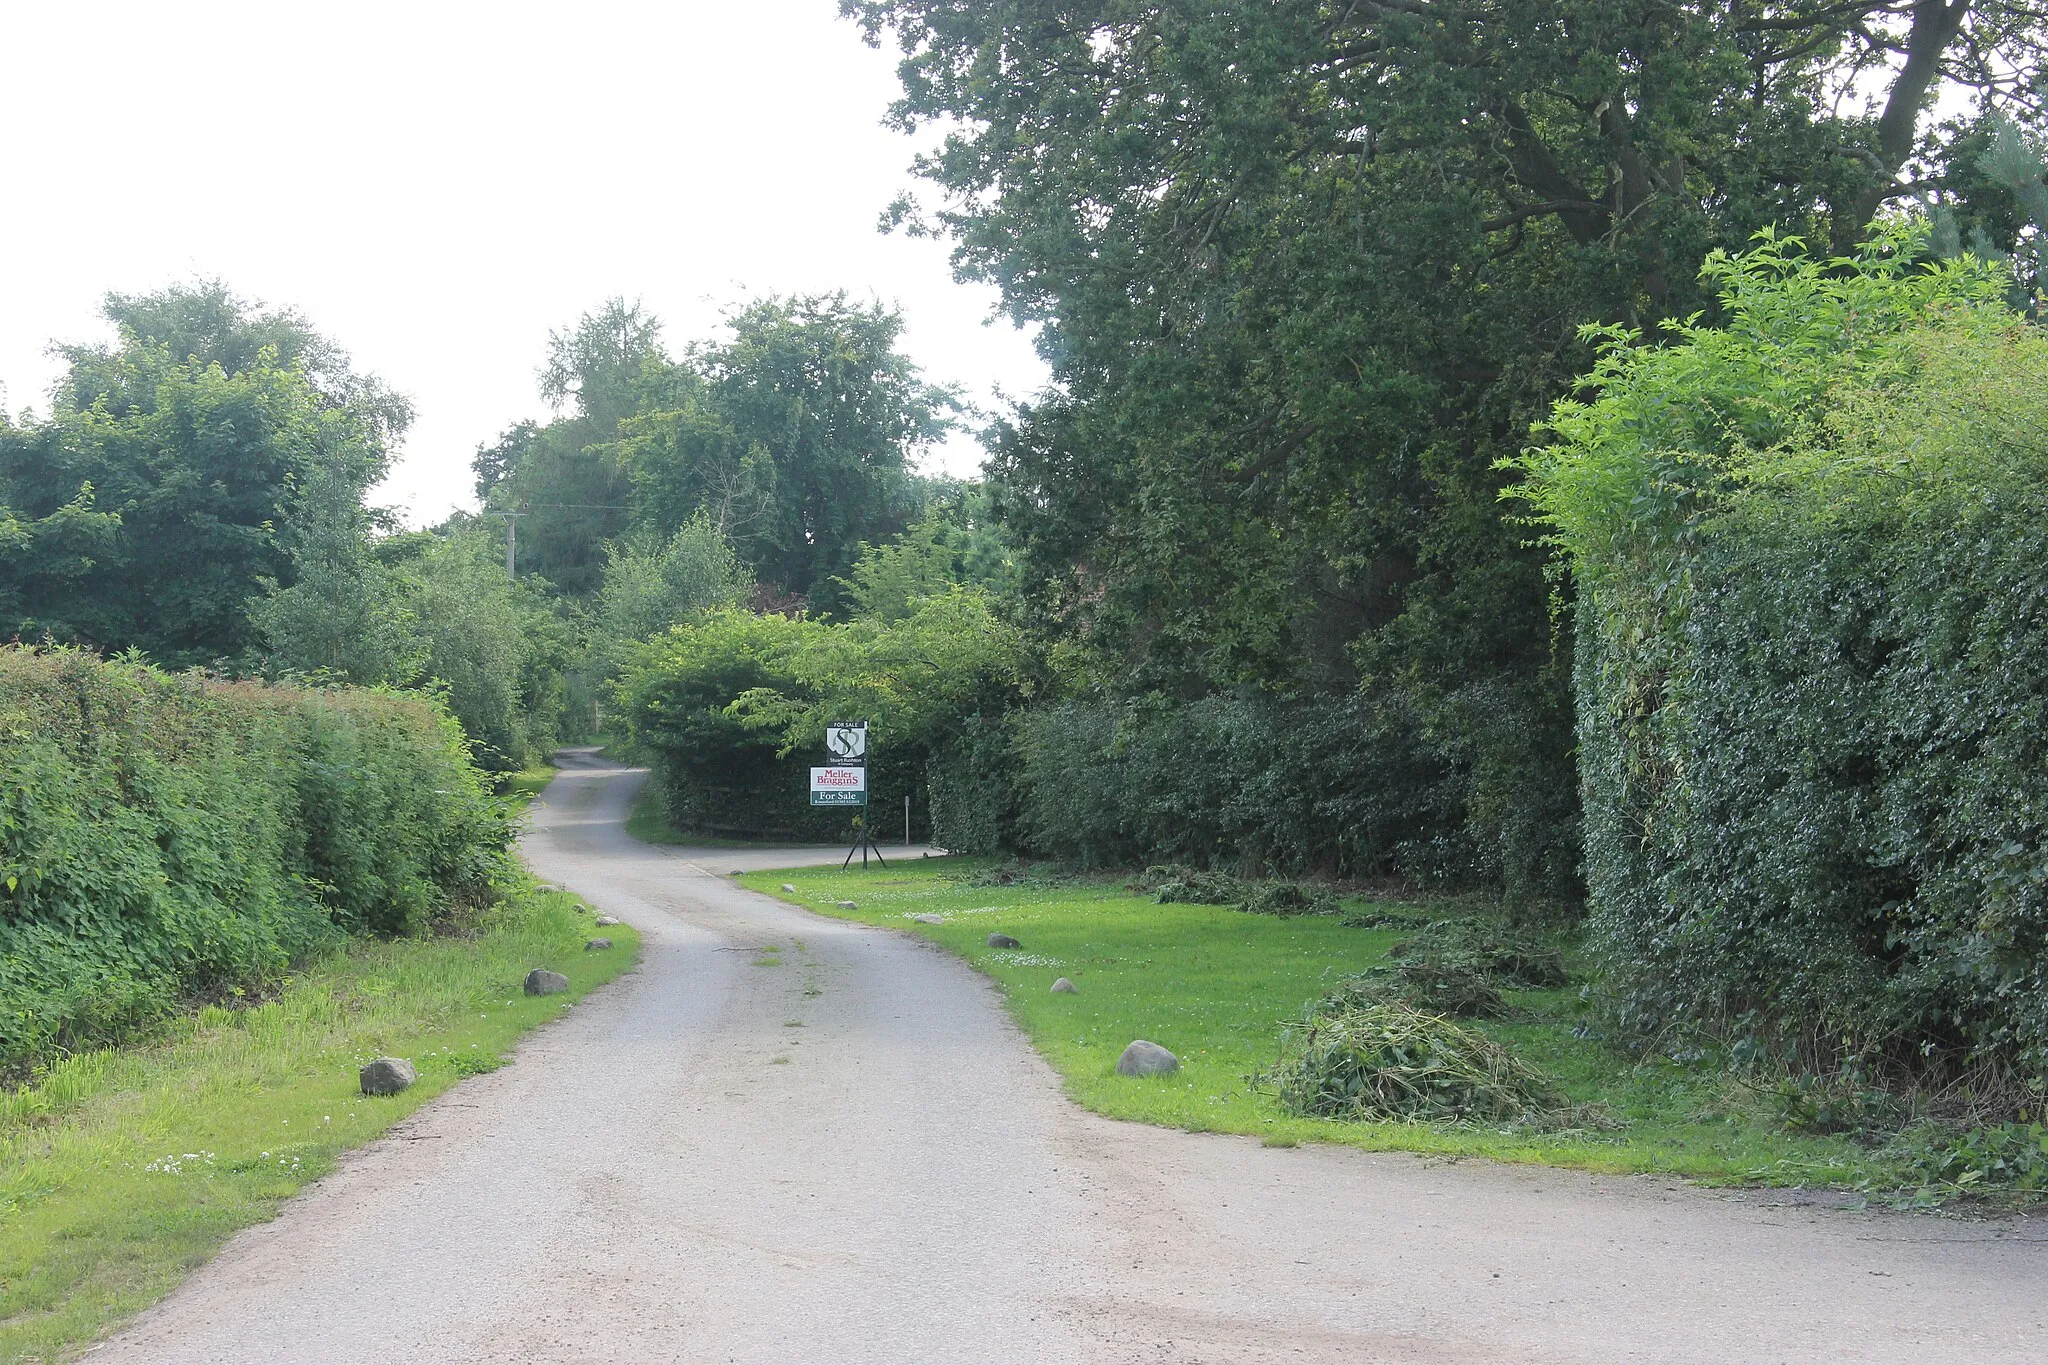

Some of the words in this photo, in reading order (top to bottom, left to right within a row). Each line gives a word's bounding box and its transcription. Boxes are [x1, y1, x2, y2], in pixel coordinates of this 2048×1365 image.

[825, 770, 853, 778] Meller
[820, 792, 836, 800] For
[838, 792, 856, 800] Sale
